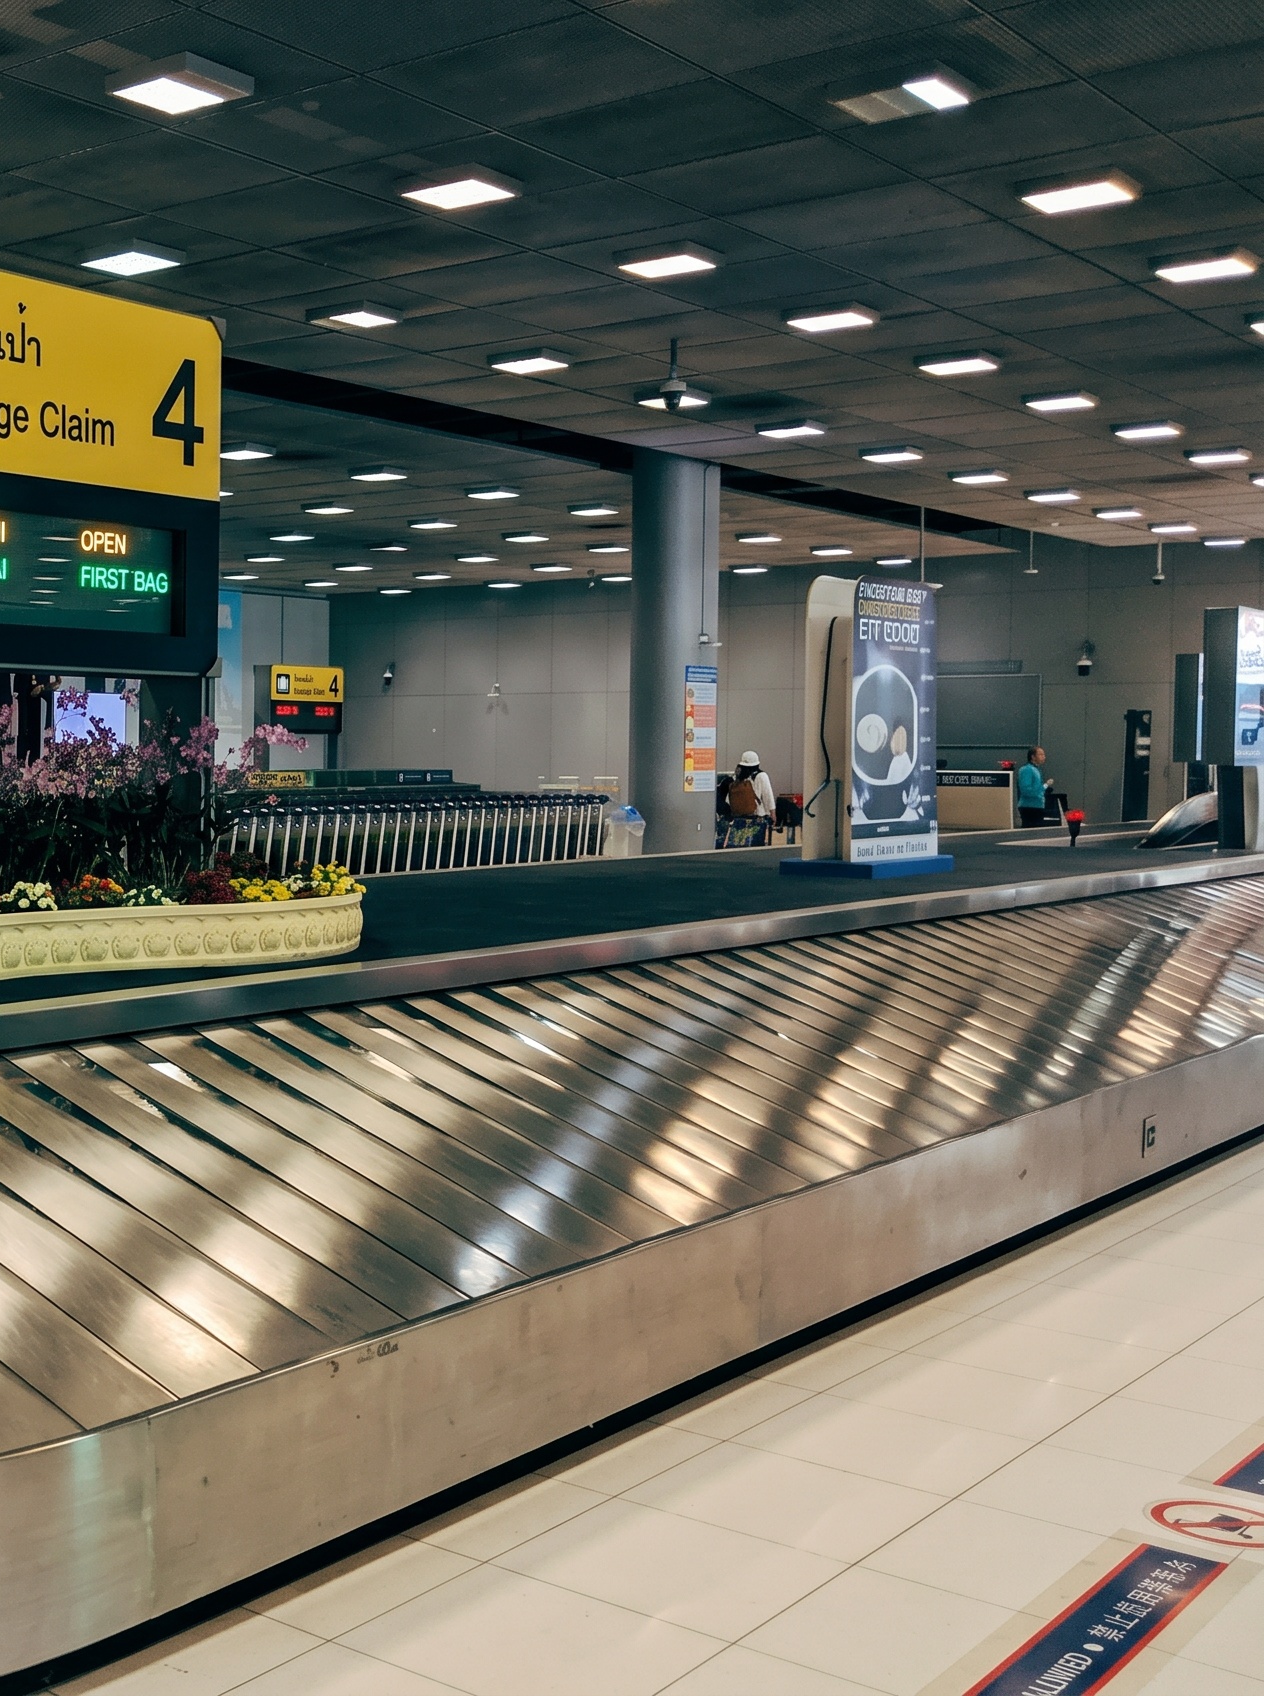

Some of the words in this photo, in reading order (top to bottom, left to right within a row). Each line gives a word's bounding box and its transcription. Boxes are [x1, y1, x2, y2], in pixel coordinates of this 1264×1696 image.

[40, 401, 115, 446] Claim
[152, 358, 205, 467] 4
[81, 530, 127, 555] OPEN
[80, 565, 130, 590] FIRST
[134, 570, 168, 594] BAG
[328, 674, 339, 697] 4
